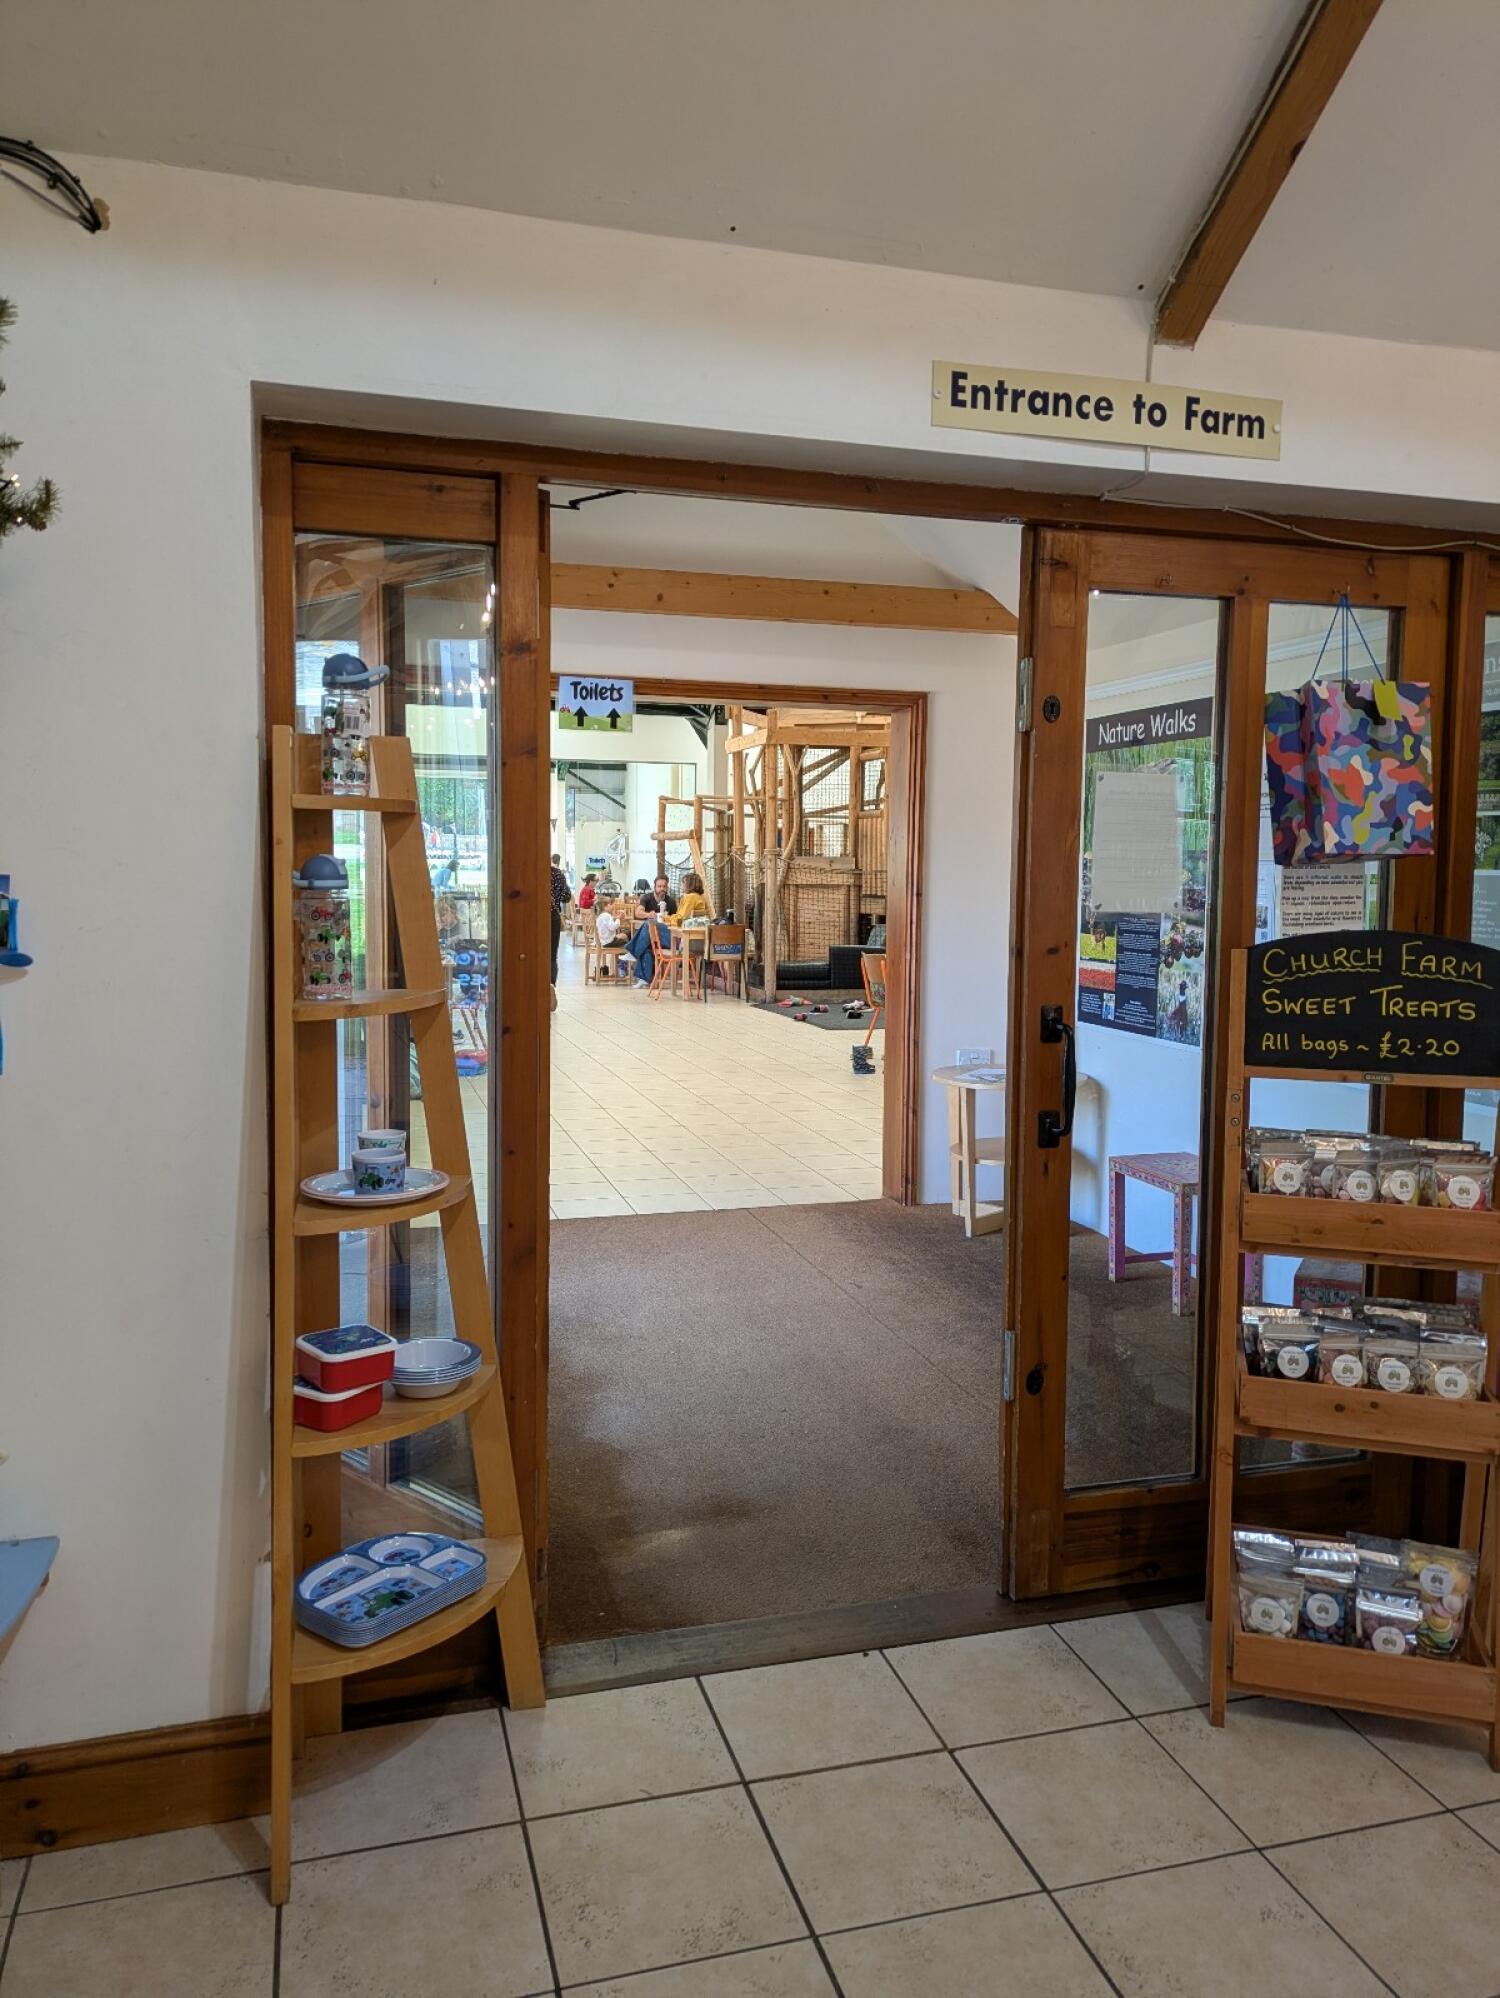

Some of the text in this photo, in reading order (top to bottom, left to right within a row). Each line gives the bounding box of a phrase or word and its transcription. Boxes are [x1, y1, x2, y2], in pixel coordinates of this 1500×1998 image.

[950, 370, 1265, 439] Entrance to Farm
[570, 680, 624, 702] Toilets
[1098, 708, 1197, 746] Nature Walks
[1263, 941, 1482, 979] CHURCH FARM
[1261, 984, 1476, 1020] SWEET TREATS
[1262, 1032, 1289, 1051] All
[1301, 1033, 1349, 1059] bags
